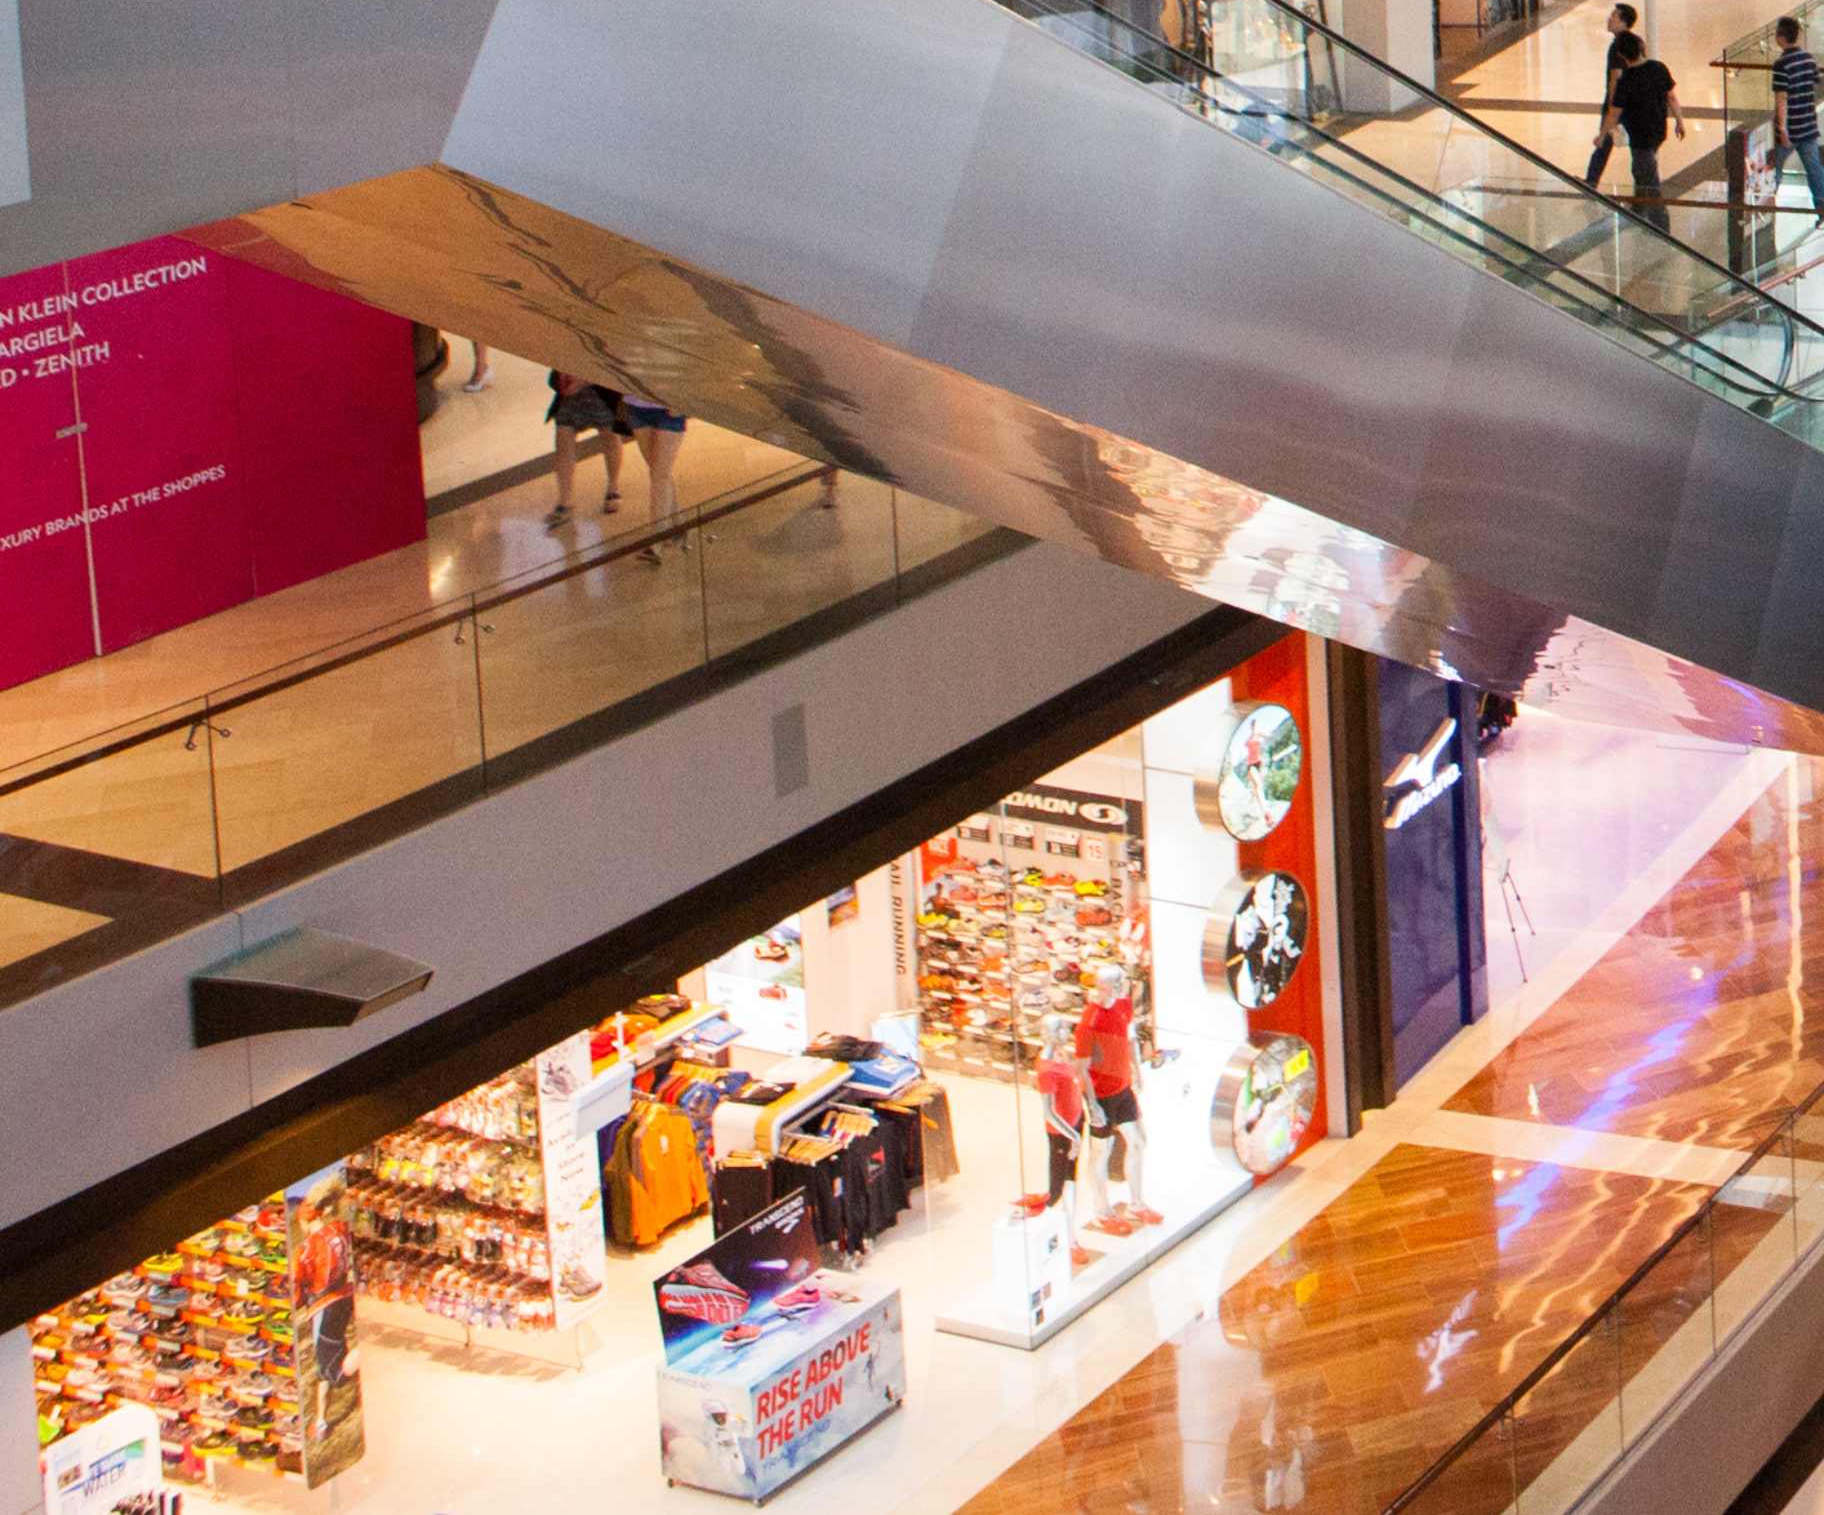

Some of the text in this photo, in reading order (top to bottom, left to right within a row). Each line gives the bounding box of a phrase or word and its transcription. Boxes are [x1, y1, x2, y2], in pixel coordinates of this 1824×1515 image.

[18, 291, 78, 323] KLEIN
[82, 256, 207, 305] COLLECTION
[34, 341, 110, 378] ZENITH
[45, 504, 109, 536] BRANDS
[110, 497, 130, 516] AT
[133, 487, 160, 507] THE
[163, 464, 226, 497] SHOPPES
[756, 1322, 873, 1425] RISE ABOVE
[757, 1377, 844, 1461] THE RUN
